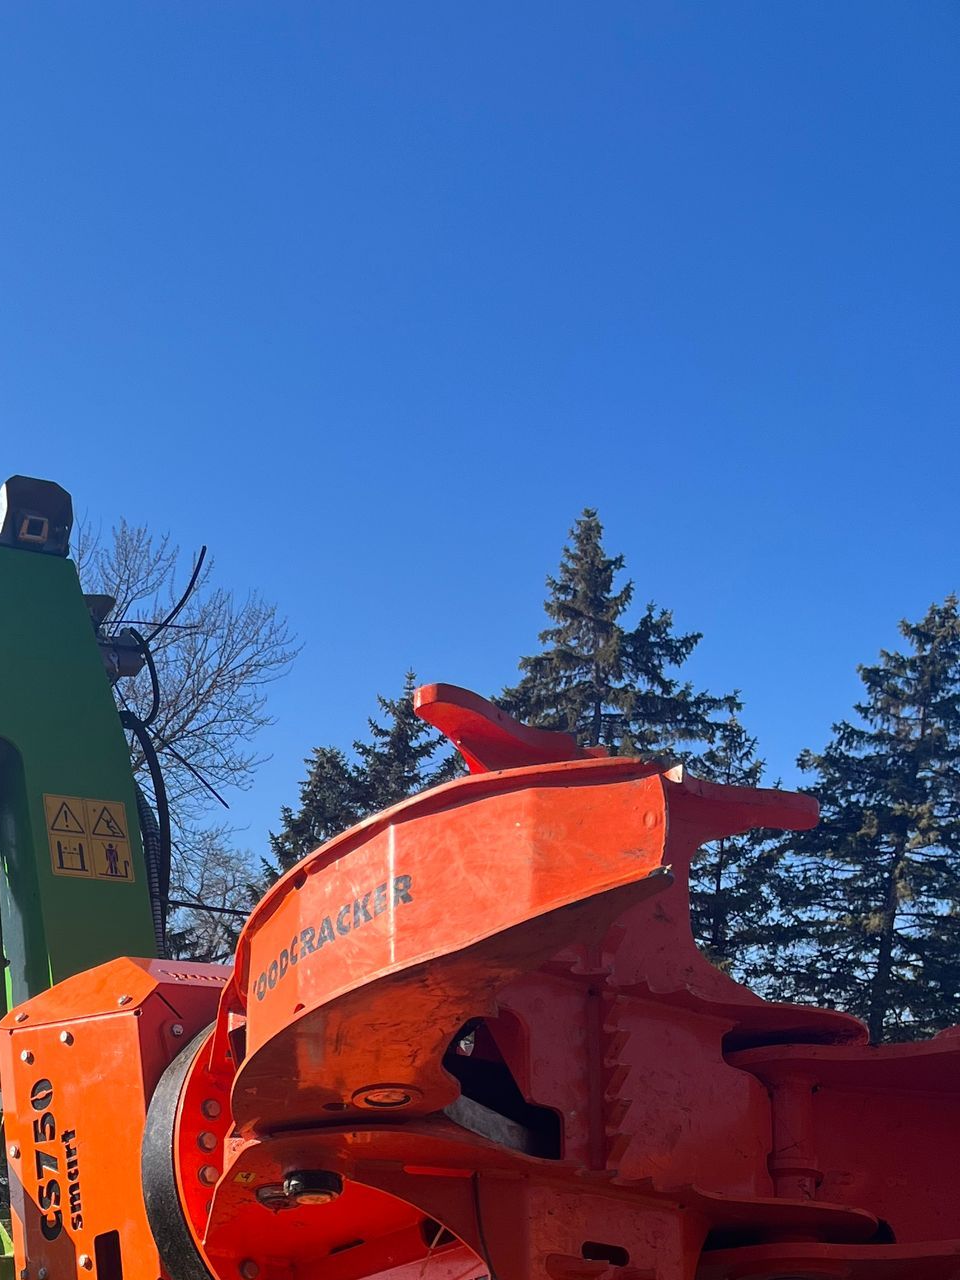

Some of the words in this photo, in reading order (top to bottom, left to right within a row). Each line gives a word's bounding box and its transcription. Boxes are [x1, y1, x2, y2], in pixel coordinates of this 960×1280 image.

[253, 874, 413, 1001] OODCRACKER
[30, 1078, 63, 1241] CS750
[61, 1129, 84, 1231] smart
